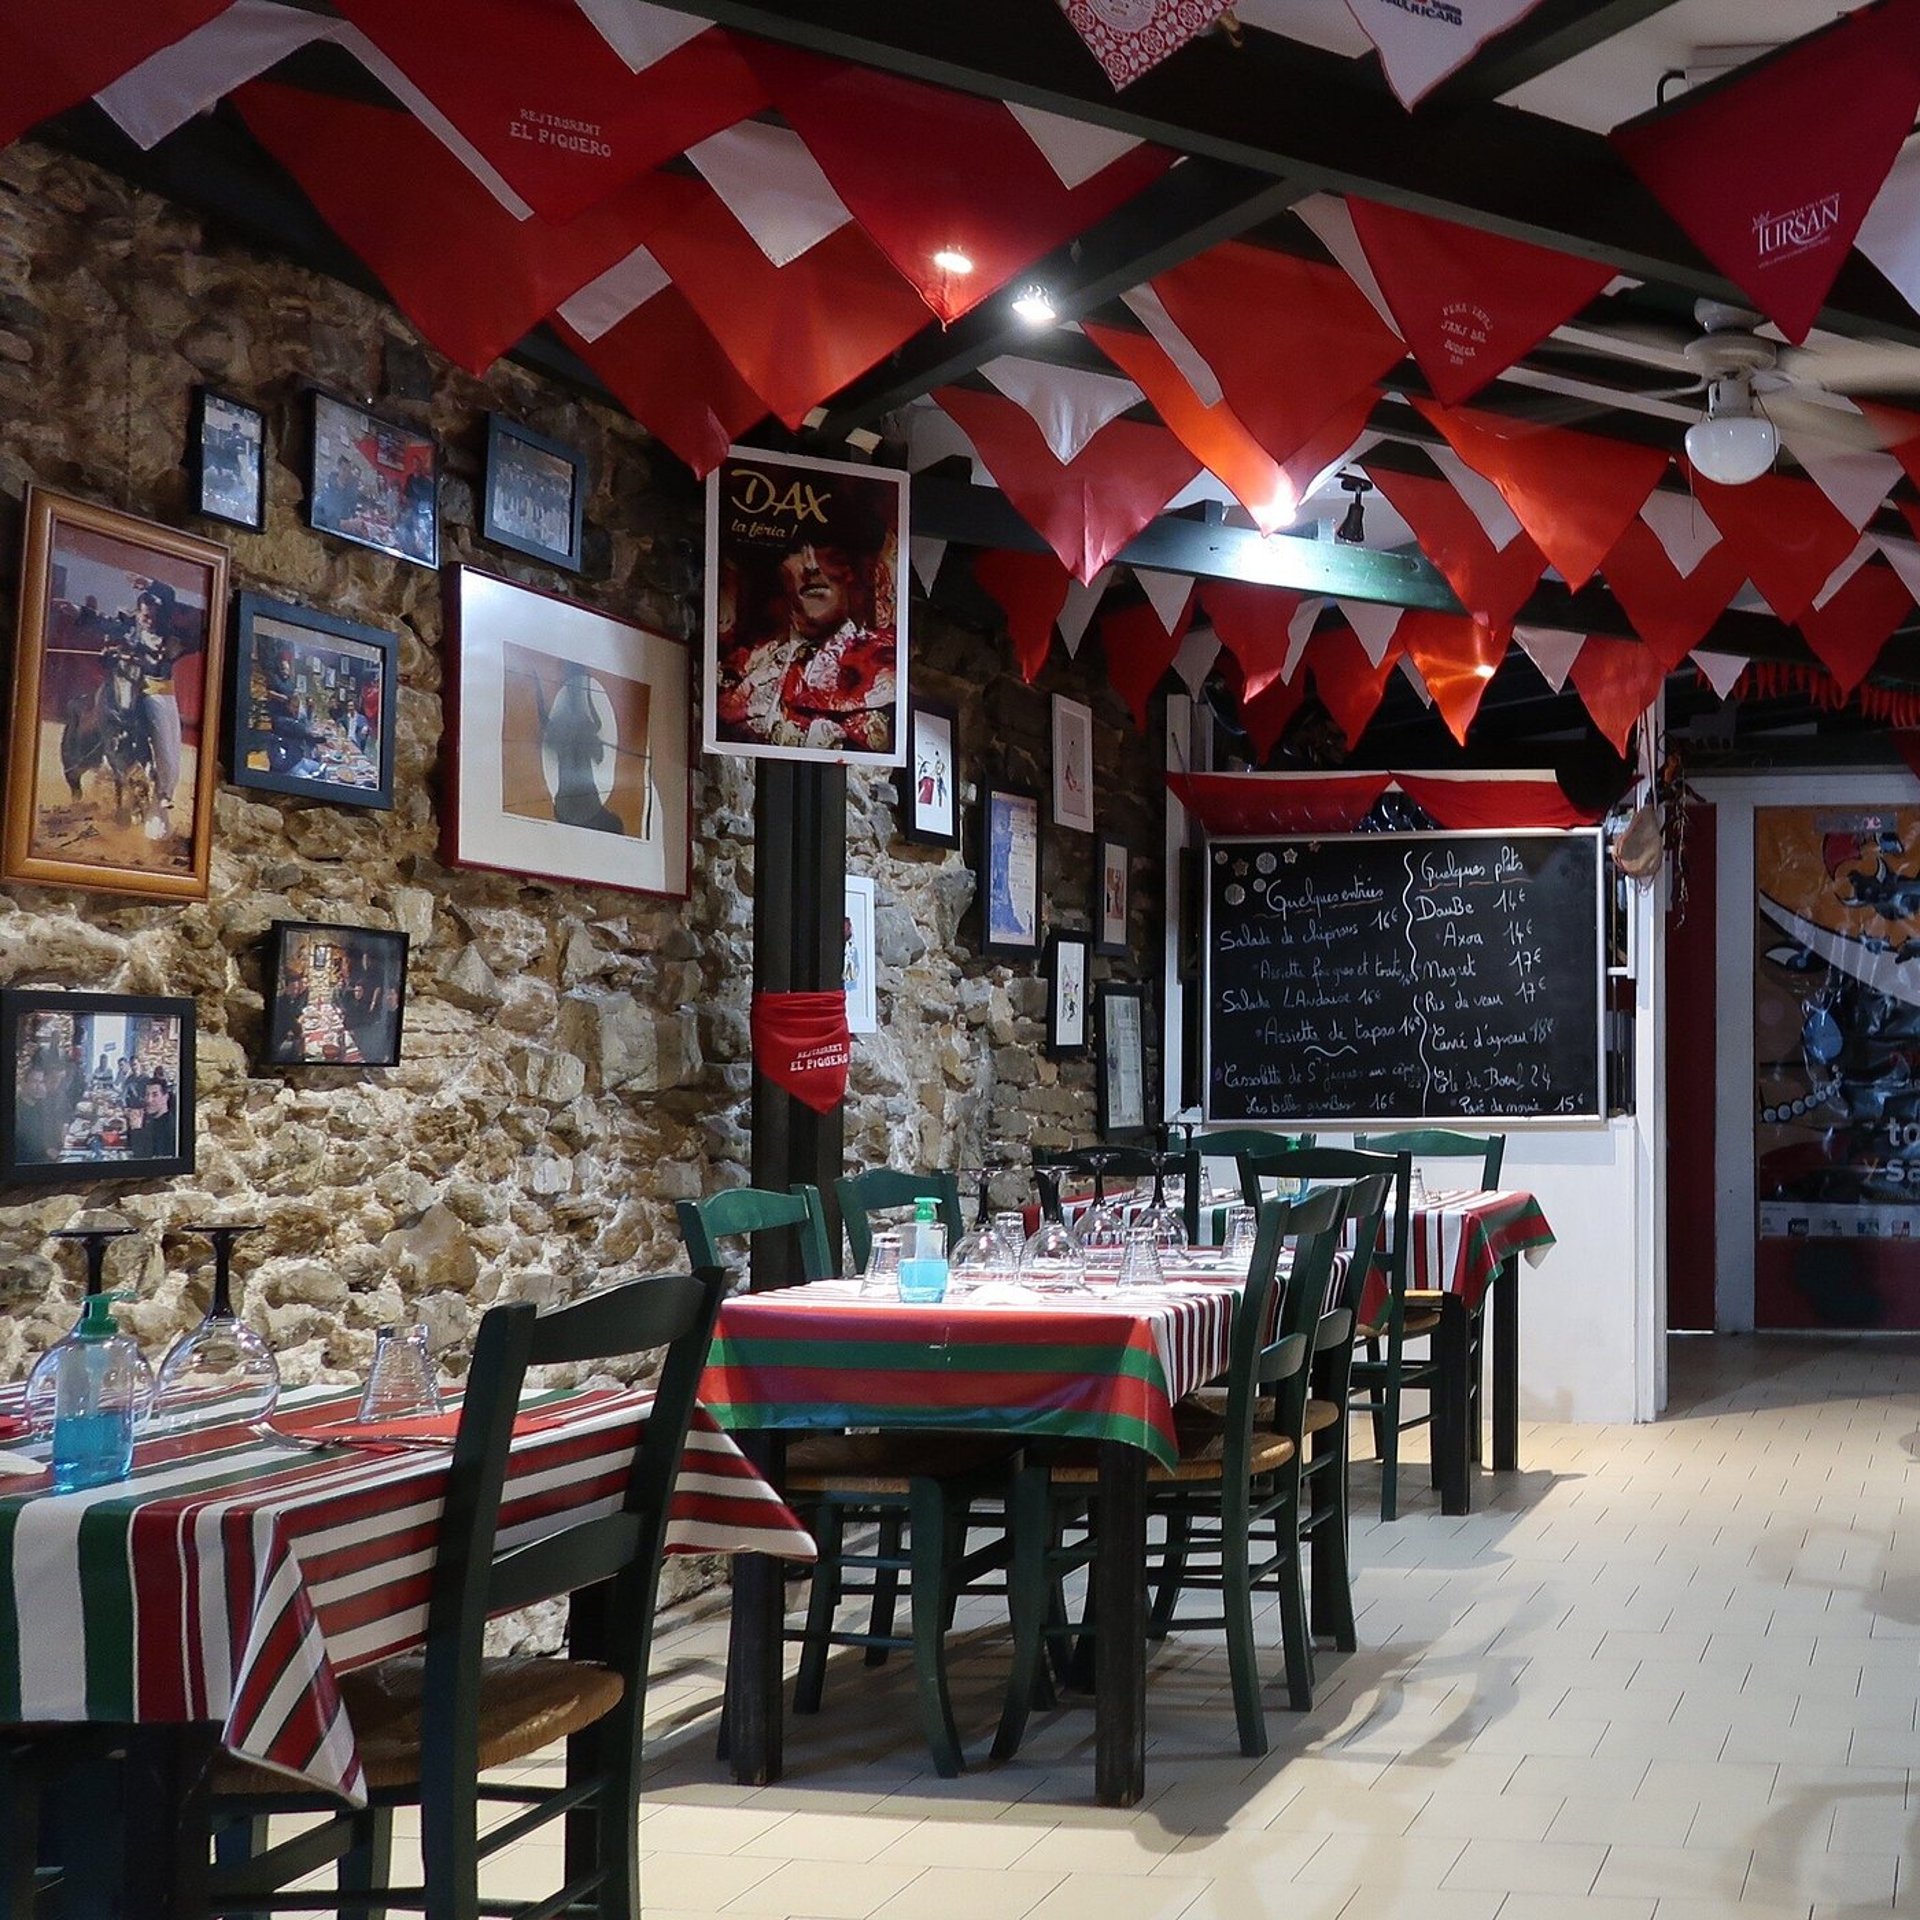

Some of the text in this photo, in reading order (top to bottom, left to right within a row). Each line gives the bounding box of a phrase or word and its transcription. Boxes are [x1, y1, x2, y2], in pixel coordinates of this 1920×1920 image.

[520, 108, 601, 137] RESTAURANT
[509, 121, 612, 158] EL PIQUERO
[1753, 197, 1840, 256] TURSAN
[730, 469, 832, 524] DAX
[731, 517, 747, 533] la
[1421, 845, 1524, 888] Quelques plats
[1220, 922, 1272, 951] Salade
[1281, 926, 1294, 946] de
[1443, 921, 1484, 947] Axoa
[1222, 988, 1270, 1012] Salade
[1425, 991, 1445, 1013] Ris
[1264, 1016, 1320, 1045] Assiette
[790, 1053, 848, 1072] EL PIQUERO
